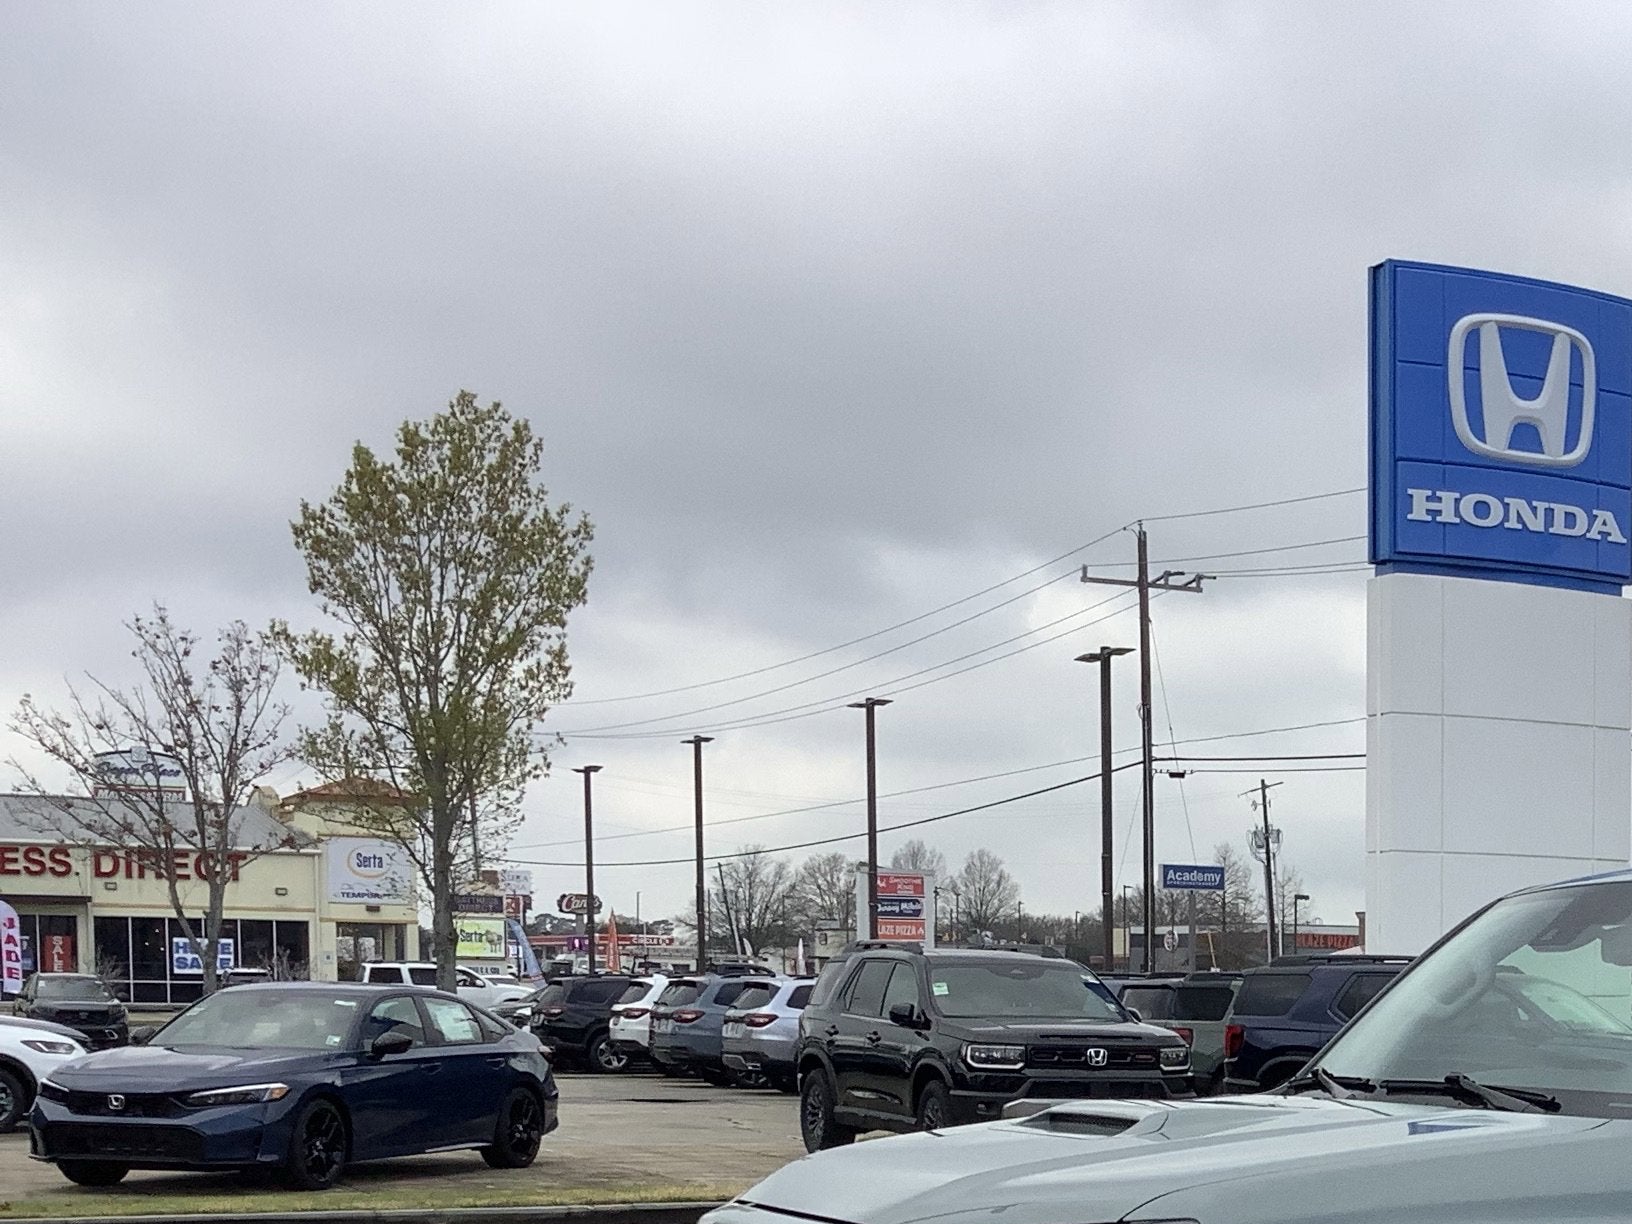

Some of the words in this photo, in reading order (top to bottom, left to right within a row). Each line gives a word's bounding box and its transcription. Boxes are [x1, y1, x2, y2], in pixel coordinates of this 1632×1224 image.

[1406, 488, 1627, 544] HONDA
[93, 850, 247, 882] DIRECT
[356, 852, 383, 869] Serta
[1167, 869, 1221, 885] Academy
[562, 895, 600, 912] Cans
[459, 928, 483, 943] Serta
[878, 924, 895, 935] LAZE
[895, 924, 917, 936] PIZZA
[3, 917, 21, 980] JADE
[52, 935, 64, 972] SALE
[175, 957, 233, 970] SAE
